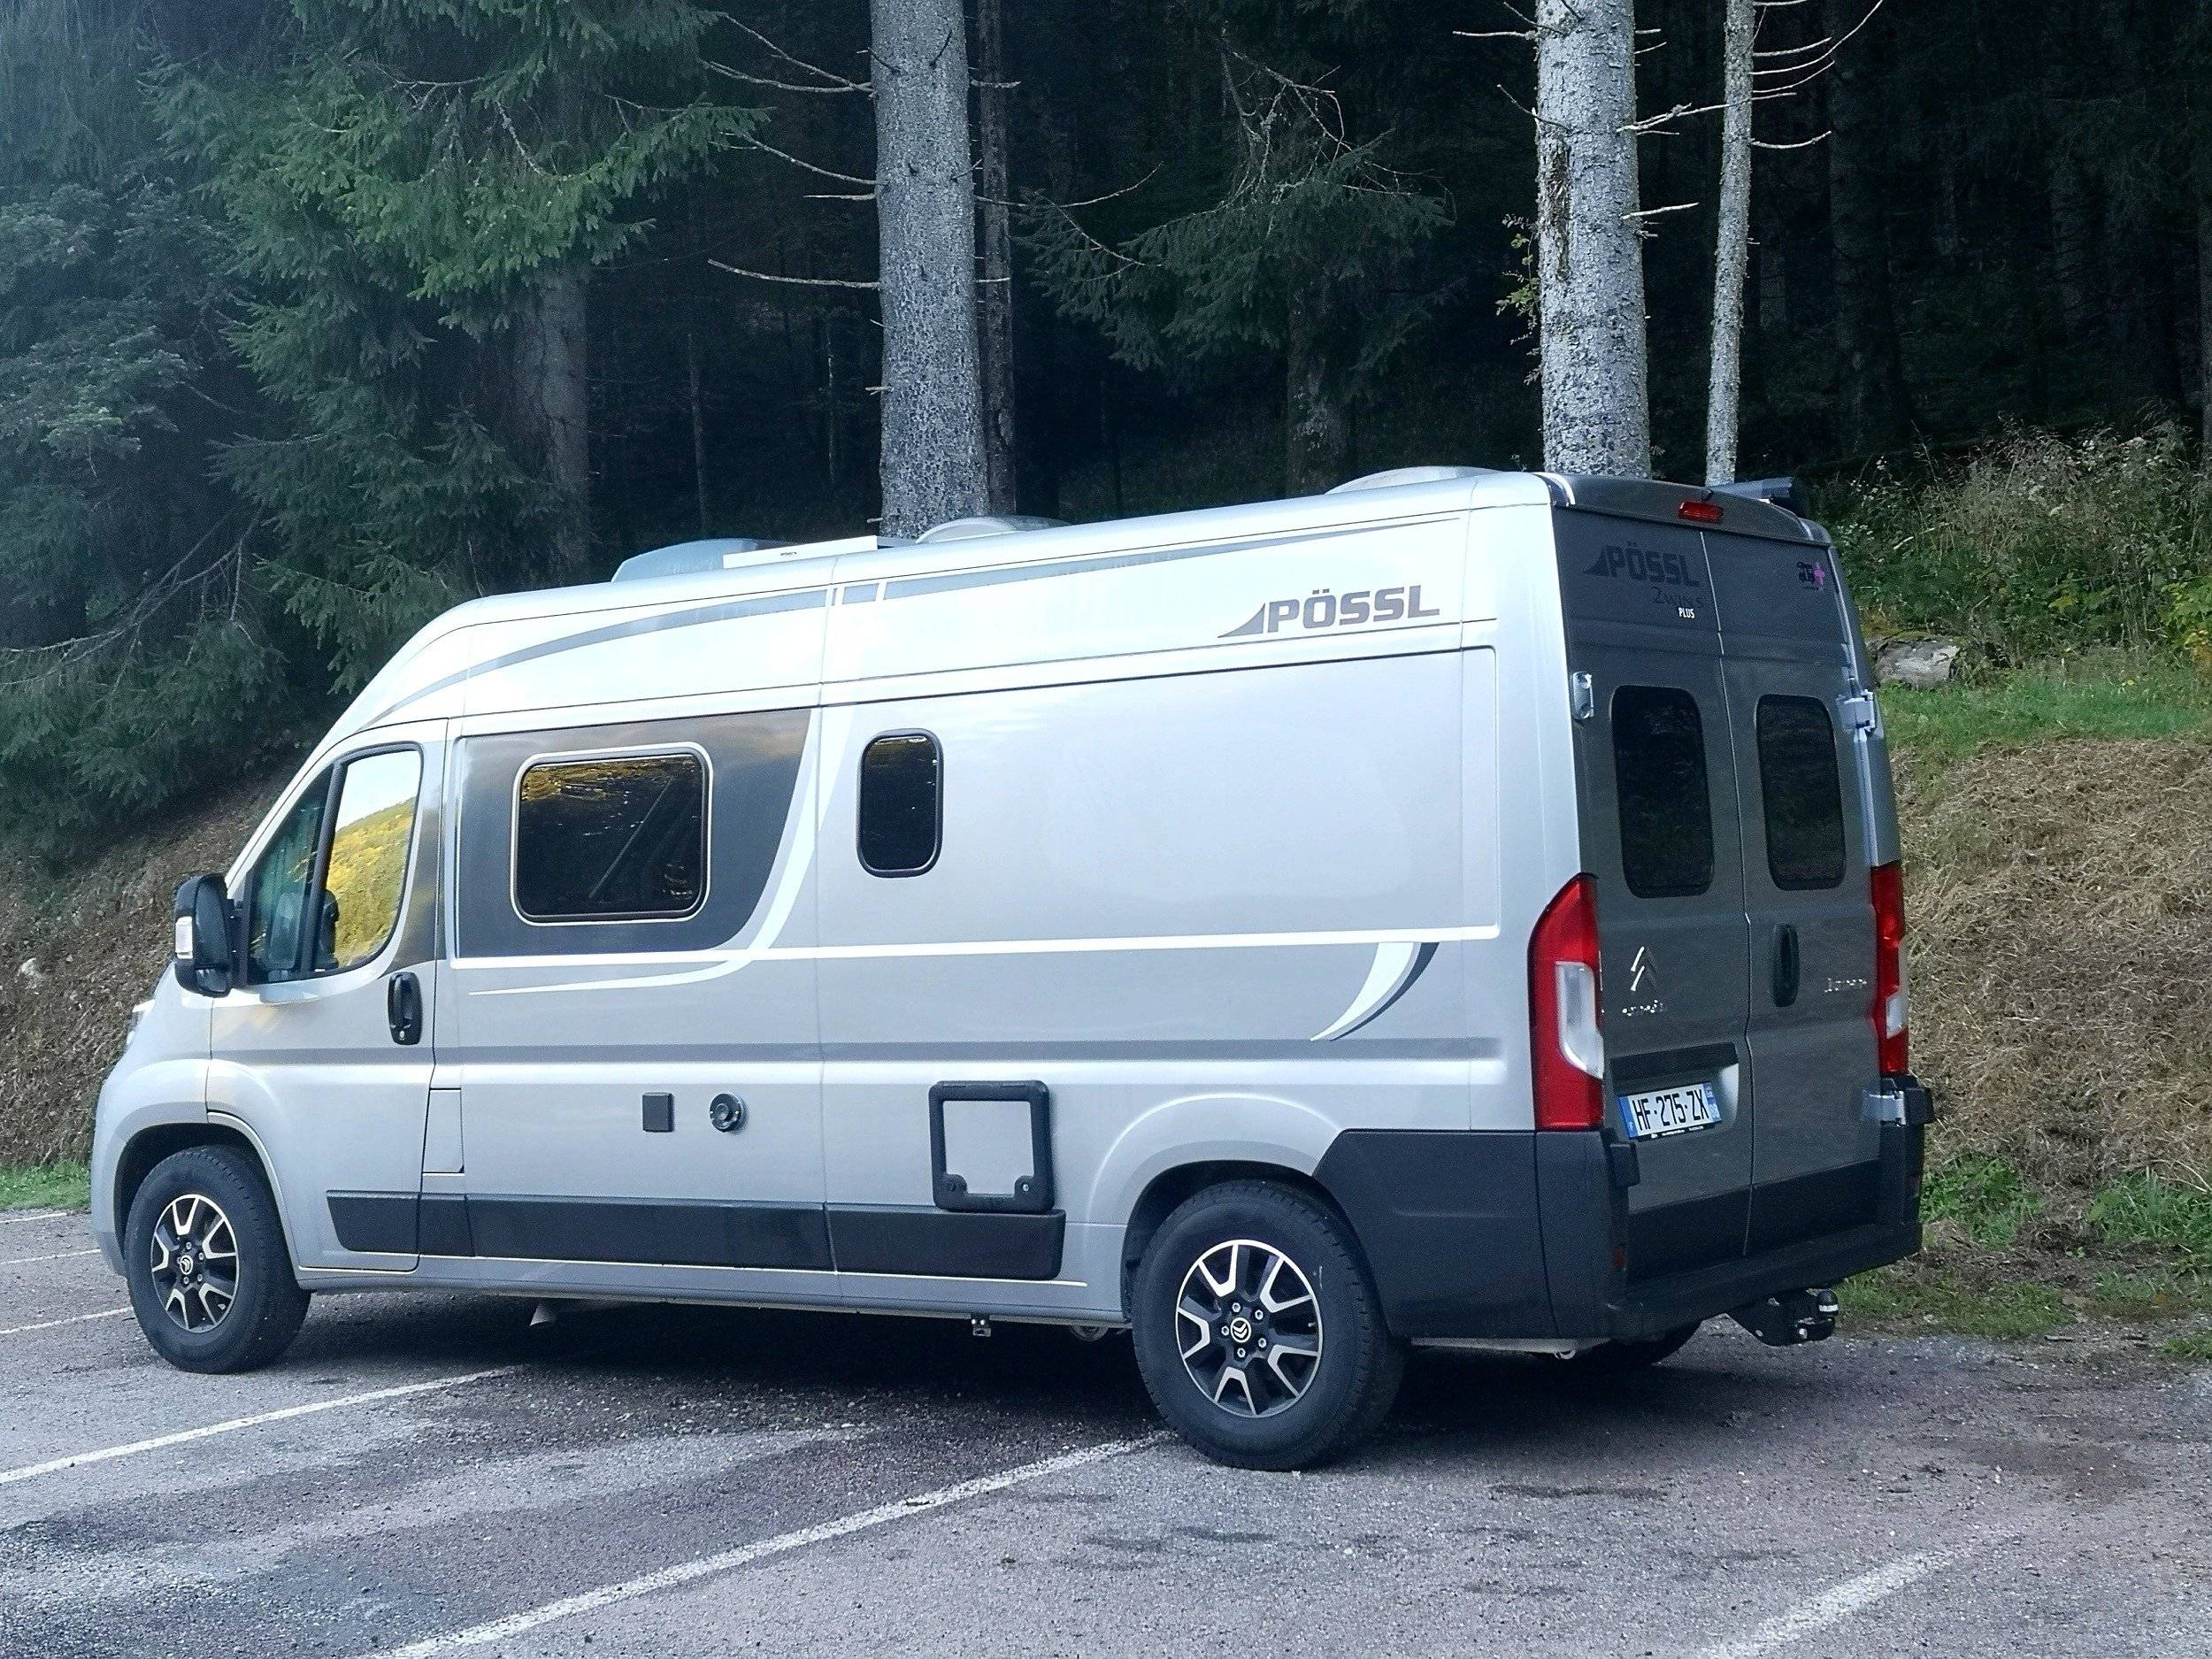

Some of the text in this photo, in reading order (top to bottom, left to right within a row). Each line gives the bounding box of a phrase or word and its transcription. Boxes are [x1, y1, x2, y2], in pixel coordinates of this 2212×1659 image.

[1605, 541, 1701, 588] PÖSSL
[1267, 585, 1440, 634] PÖSSL
[1678, 607, 1695, 619] PLUS
